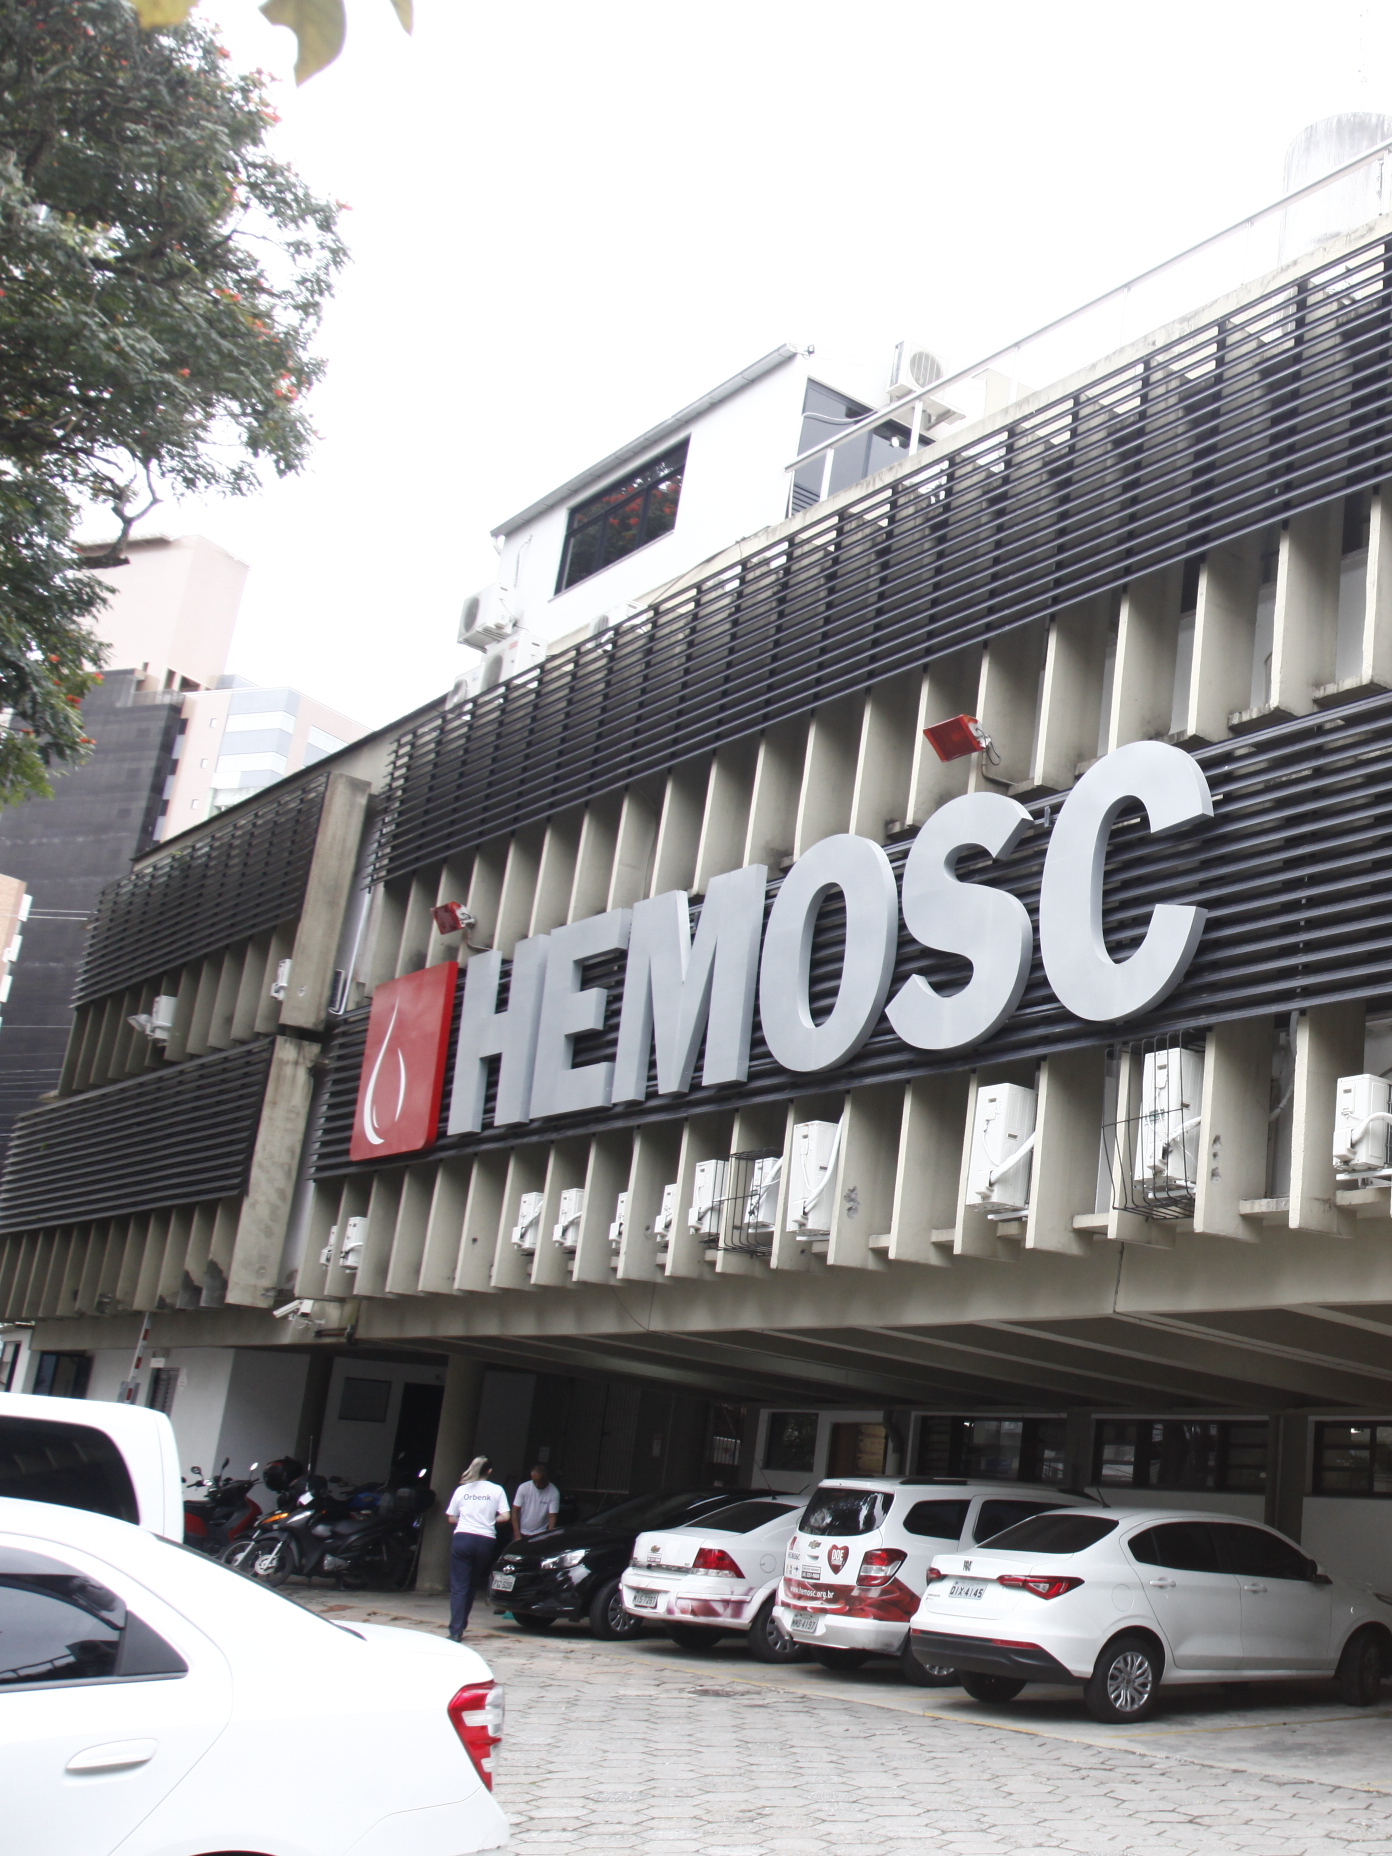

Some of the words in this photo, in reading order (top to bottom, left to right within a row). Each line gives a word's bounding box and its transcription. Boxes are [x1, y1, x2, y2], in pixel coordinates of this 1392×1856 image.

[447, 740, 1213, 1136] HEMOSC
[463, 1493, 491, 1501] Orbenk
[831, 1549, 844, 1560] DOE
[790, 1586, 835, 1600] www.hemosc.org.br
